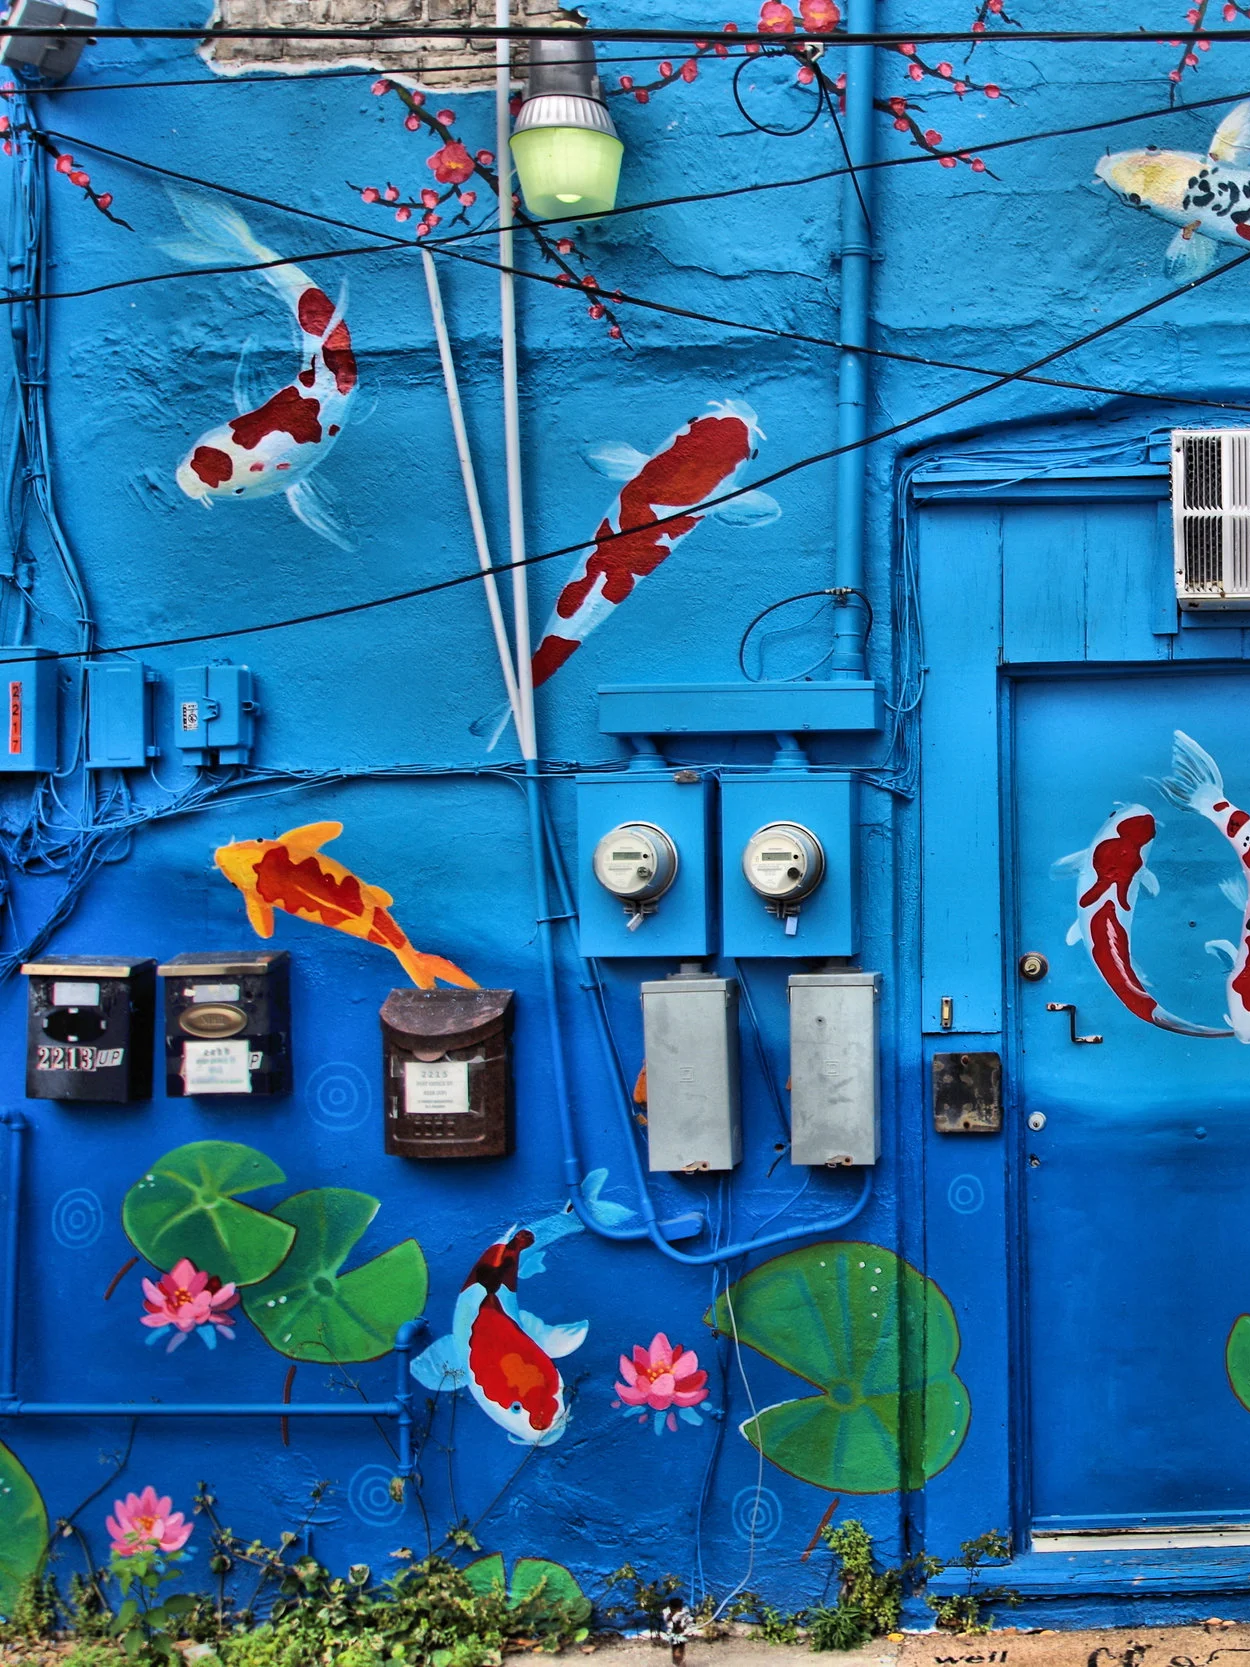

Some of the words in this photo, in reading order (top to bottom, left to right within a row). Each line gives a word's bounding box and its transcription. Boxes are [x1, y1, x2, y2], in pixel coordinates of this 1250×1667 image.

[11, 685, 20, 753] 2217
[36, 1047, 94, 1071] 2213
[98, 1050, 121, 1065] UP
